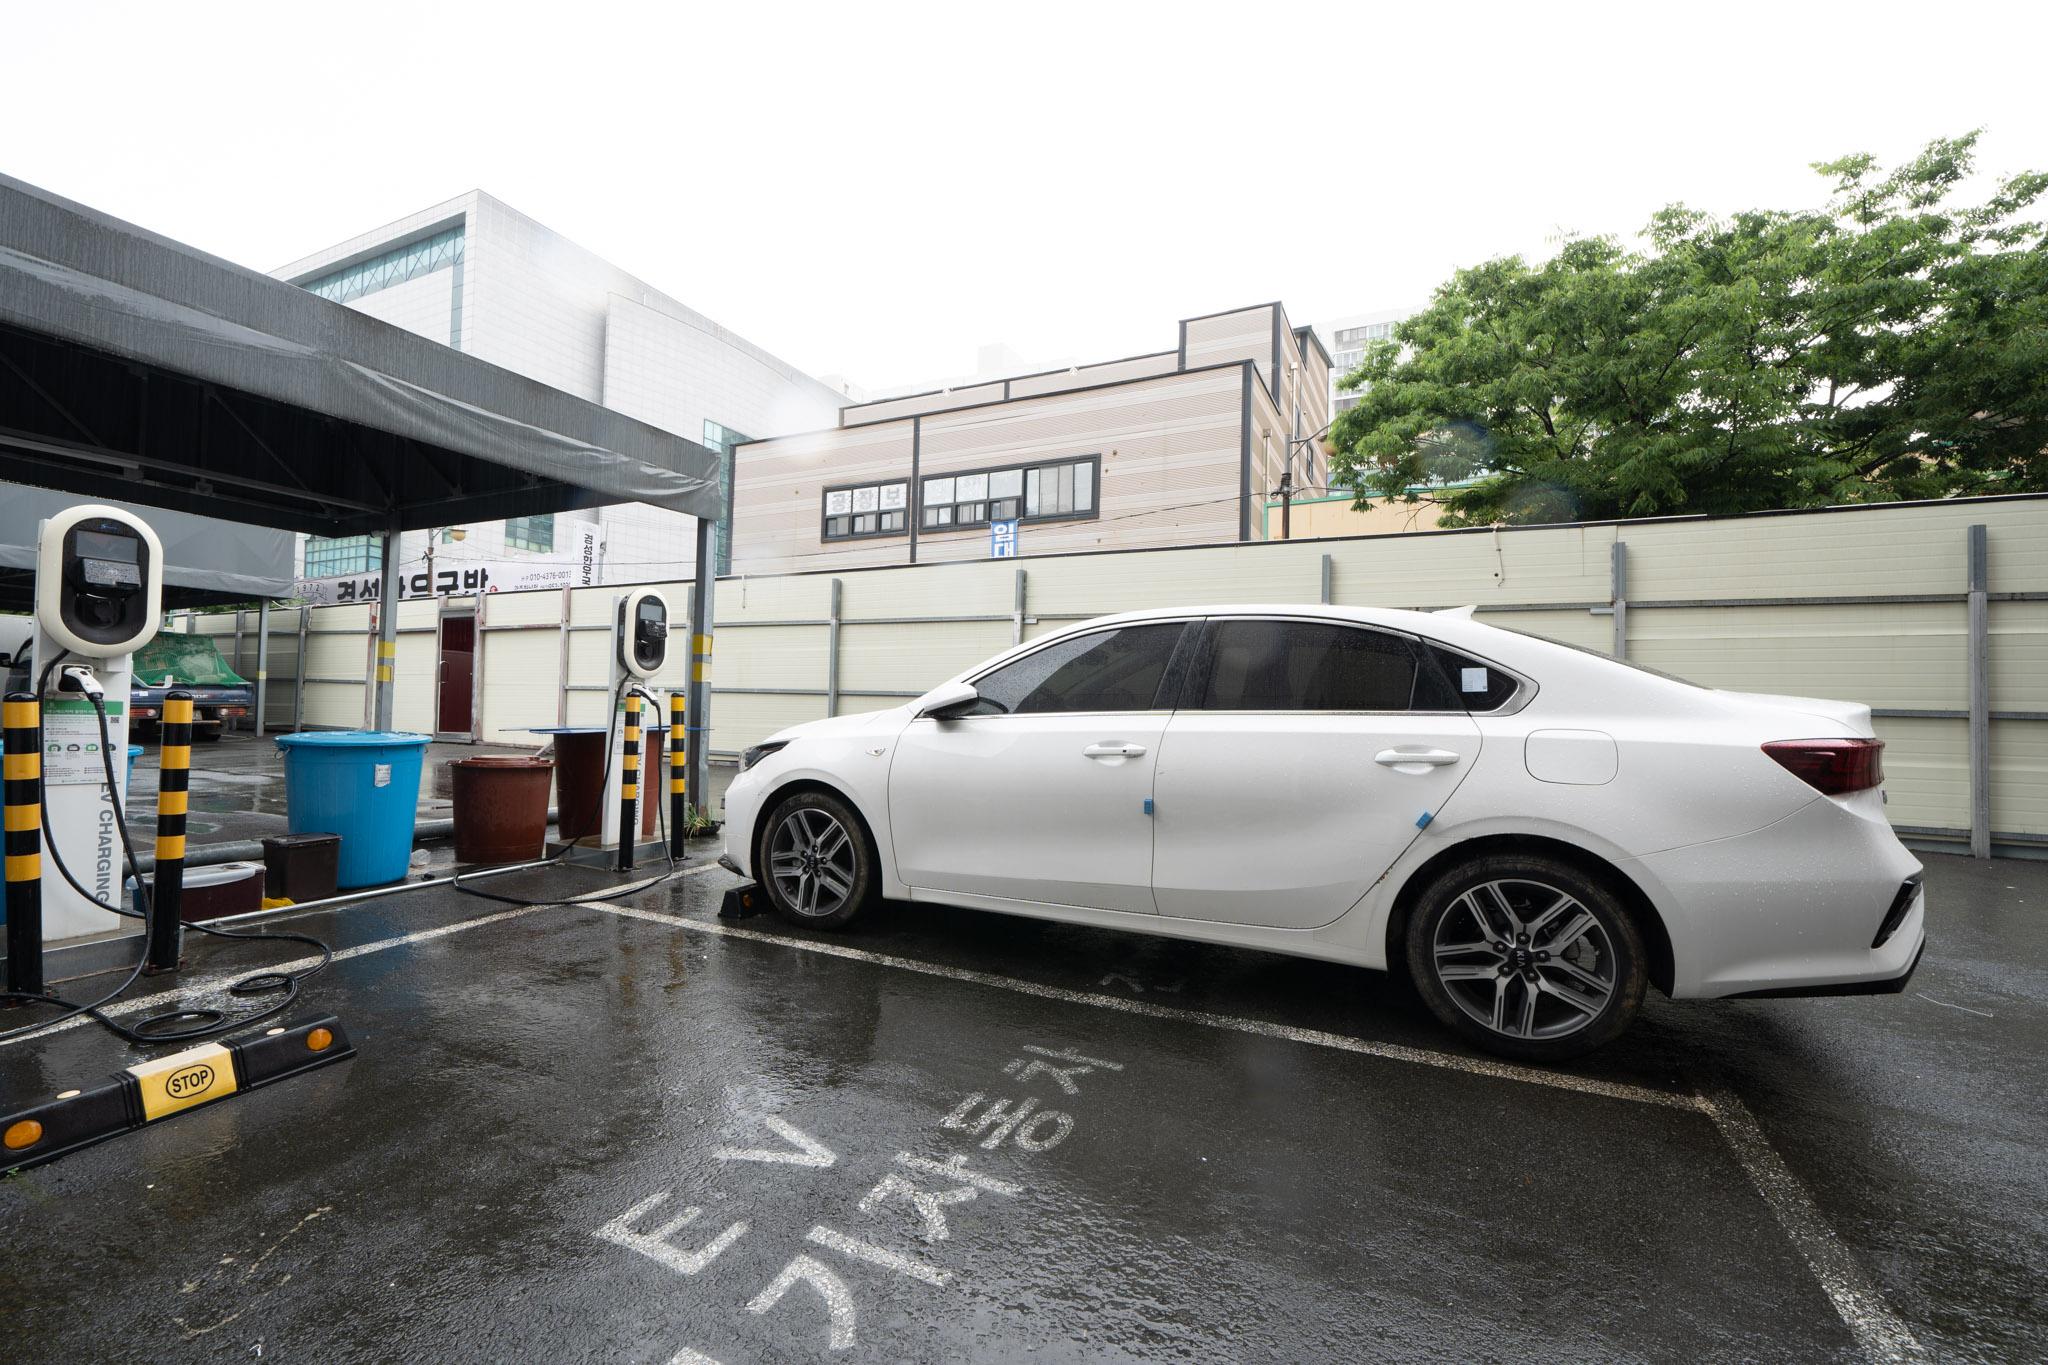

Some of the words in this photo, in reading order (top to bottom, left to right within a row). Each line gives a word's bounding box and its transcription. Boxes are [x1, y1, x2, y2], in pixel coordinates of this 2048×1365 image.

[994, 525, 1014, 557] 임대
[296, 583, 320, 594] 1972
[95, 809, 113, 903] CHARGING
[172, 1070, 208, 1093] STOP
[594, 1114, 838, 1277] EV
